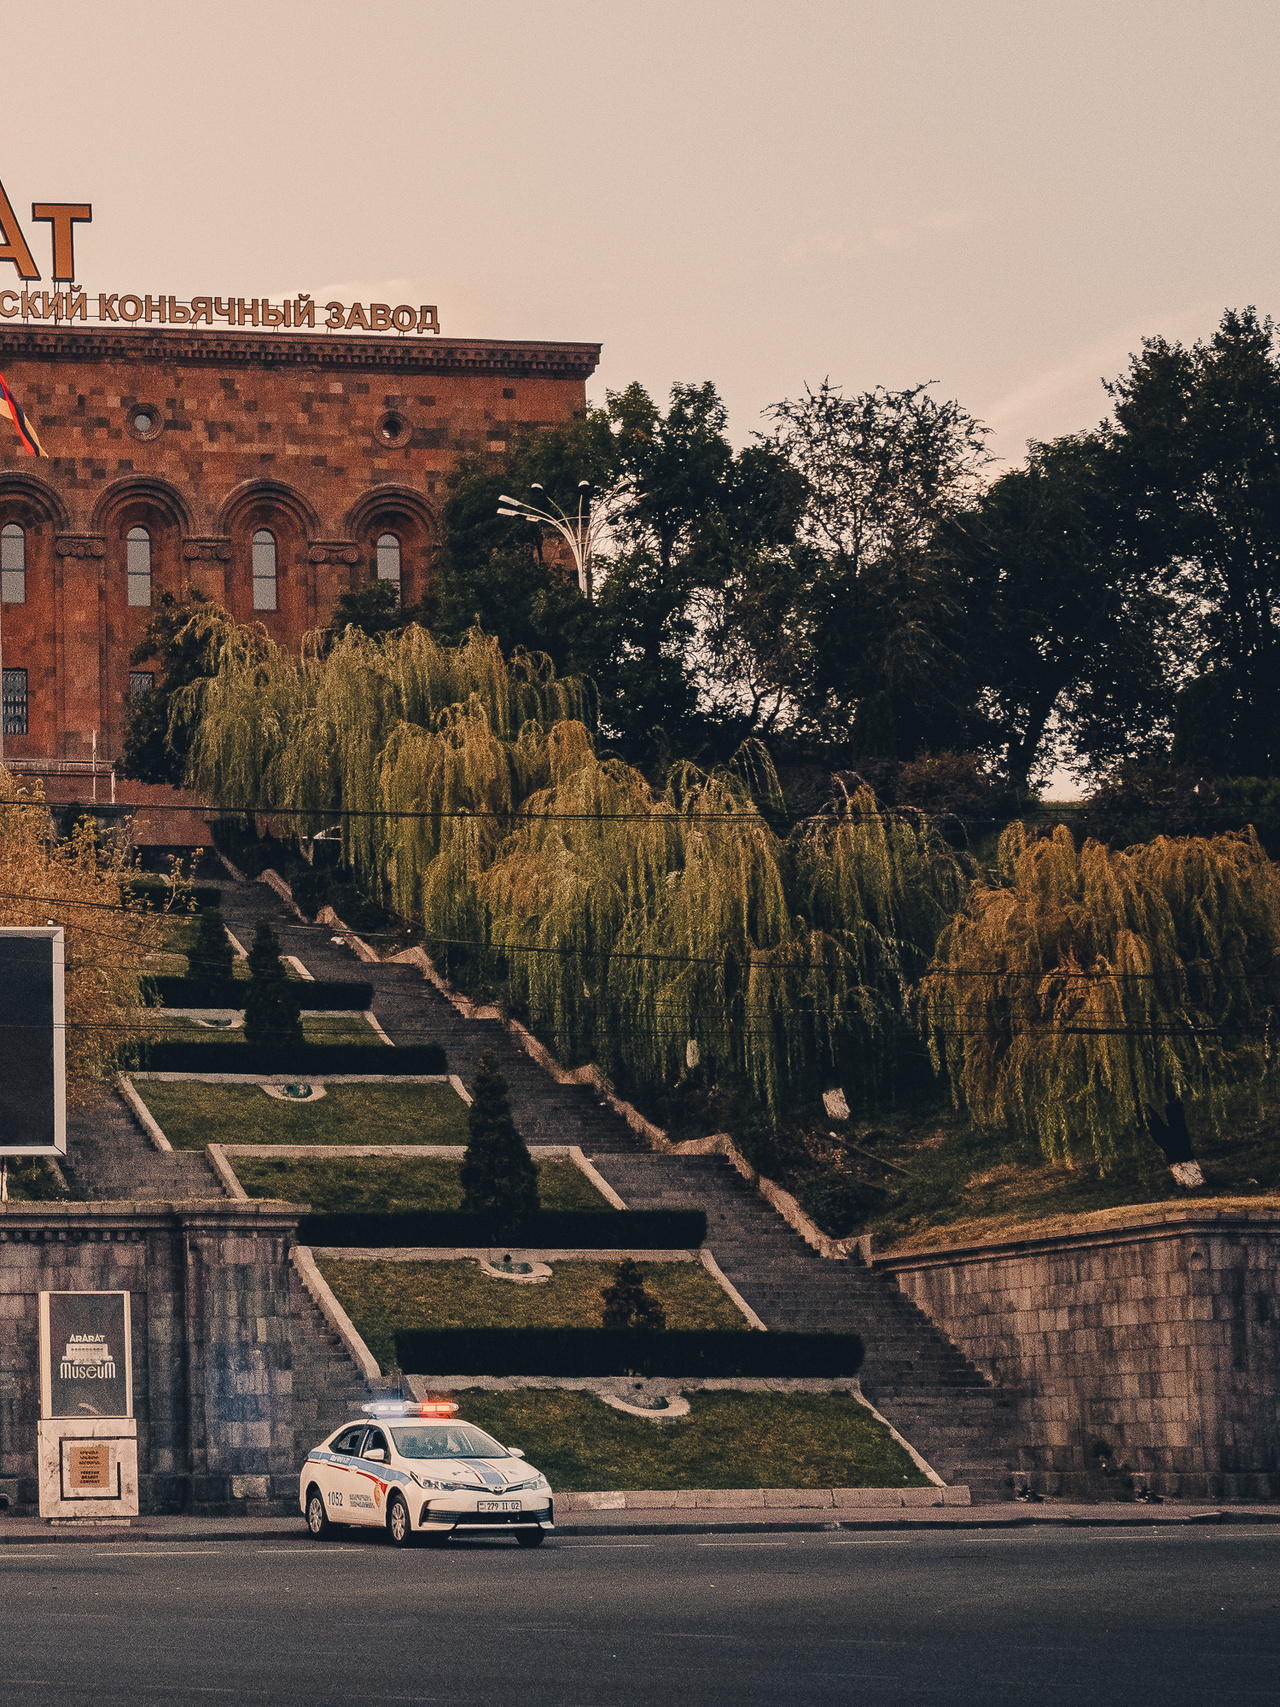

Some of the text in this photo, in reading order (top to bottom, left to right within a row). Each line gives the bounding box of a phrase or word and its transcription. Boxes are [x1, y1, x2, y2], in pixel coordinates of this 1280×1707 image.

[99, 293, 317, 328] КОНЬЯЧНЫЙ
[324, 301, 441, 335] ЗАВОД
[69, 1333, 105, 1342] ARARAT
[327, 1491, 343, 1507] 1052
[487, 1502, 499, 1510] 279
[511, 1502, 519, 1510] 02
